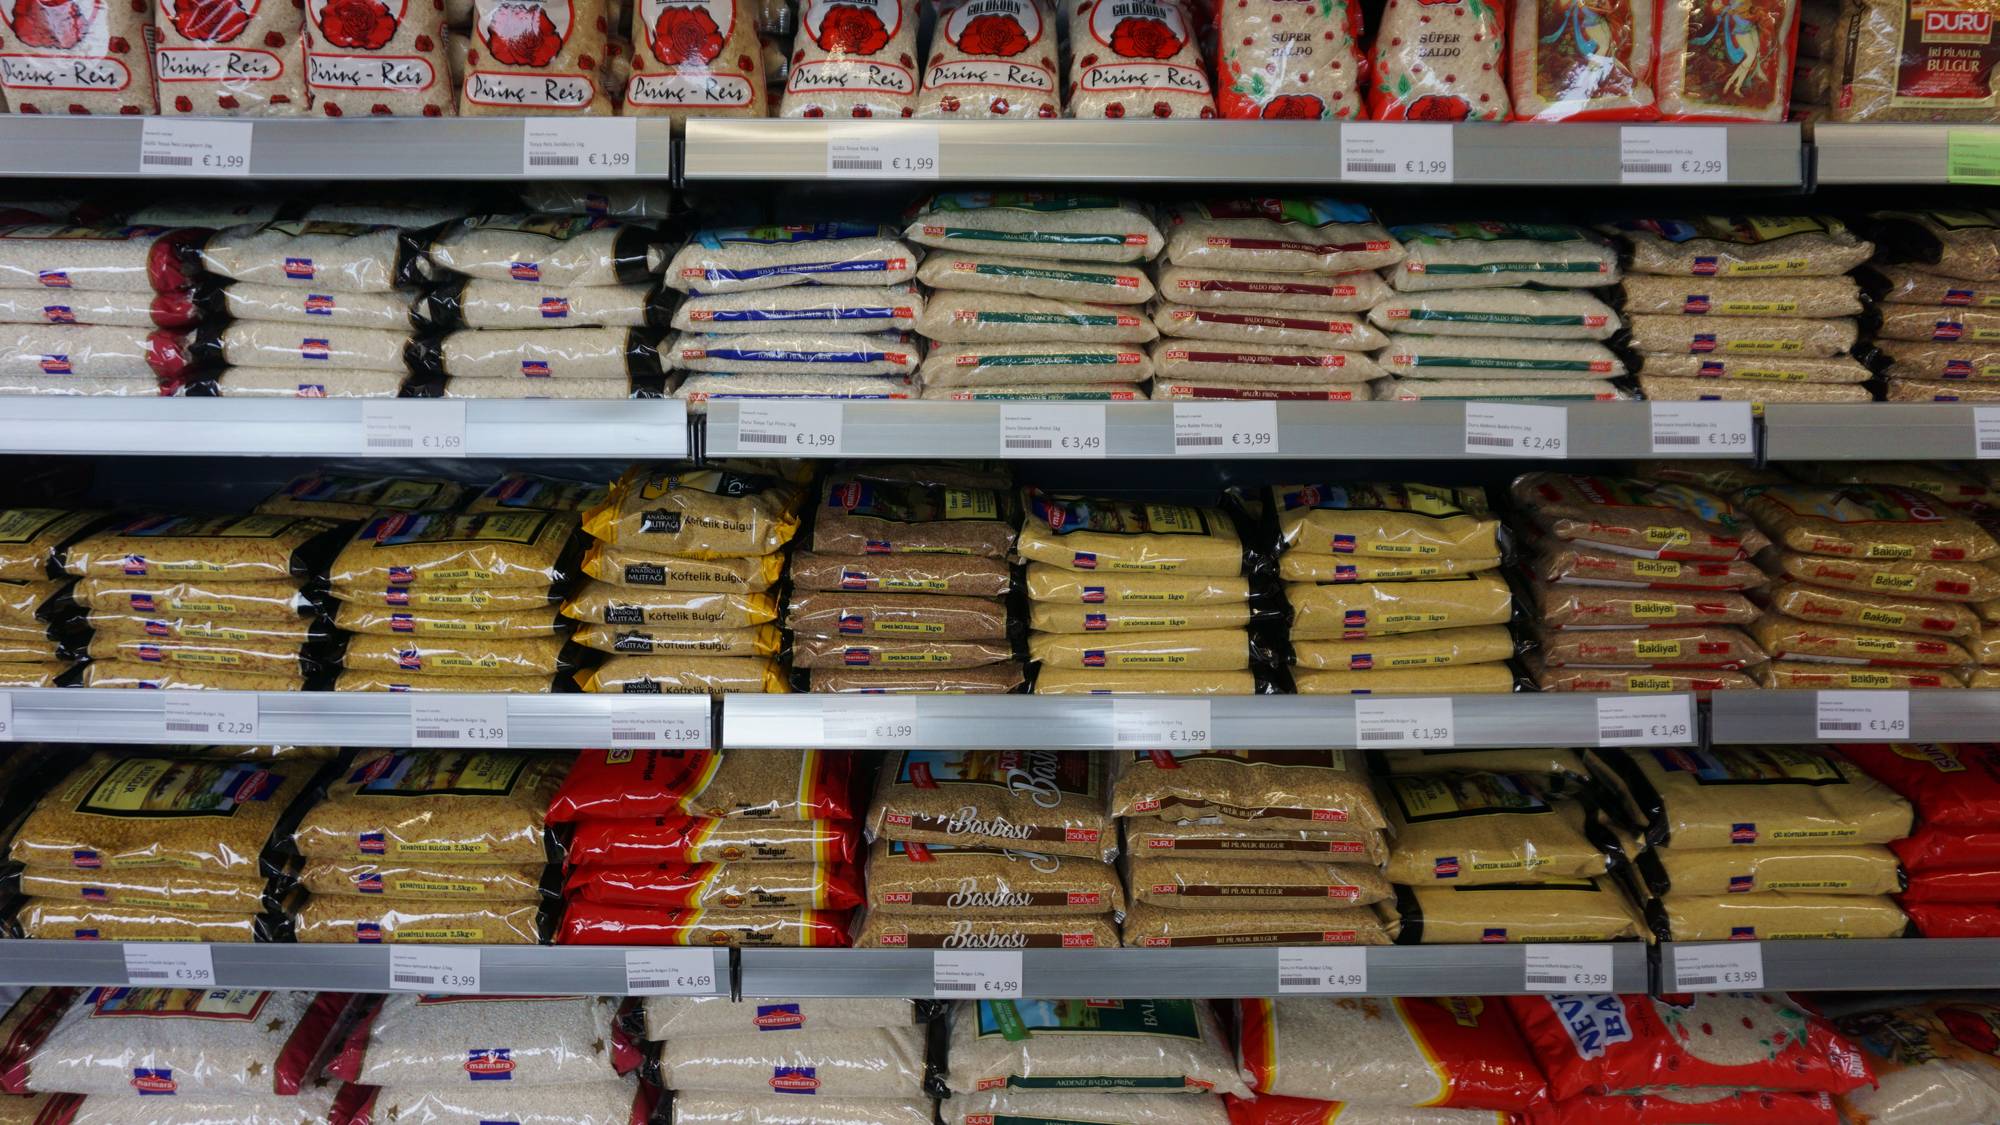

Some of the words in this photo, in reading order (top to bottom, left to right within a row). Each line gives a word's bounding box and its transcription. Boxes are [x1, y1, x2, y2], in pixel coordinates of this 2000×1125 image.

[1927, 12, 1989, 31] DURU
[1271, 32, 1311, 44] SÜPER
[1419, 32, 1460, 44] SÜPER
[228, 53, 269, 74] Reis
[1927, 60, 1980, 72] BULGUR
[74, 61, 117, 85] Reis
[382, 62, 422, 84] Reis
[1008, 65, 1043, 86] Reis
[1167, 68, 1201, 88] Reis
[474, 74, 525, 102] Pirinç
[545, 78, 584, 101] Reis
[706, 78, 743, 101] Reis
[202, 154, 211, 166] €
[216, 155, 244, 168] 1,99
[589, 153, 596, 164] €
[602, 153, 629, 166] 1,99
[892, 158, 900, 169] €
[905, 158, 933, 171] 1,99
[1406, 161, 1414, 172] €
[1419, 161, 1446, 174] 1,99
[1681, 160, 1690, 172] €
[1693, 160, 1721, 174] 2,99
[1180, 280, 1199, 288] DURU
[1168, 349, 1187, 358] DURU
[1172, 386, 1191, 395] DURU
[422, 436, 430, 447] €
[434, 436, 460, 449] 1,69
[796, 433, 804, 444] €
[808, 433, 835, 447] 1,99
[1061, 437, 1069, 448] €
[1072, 437, 1099, 450] 3,49
[1232, 433, 1240, 444] €
[1244, 433, 1270, 446] 3,99
[1522, 436, 1531, 447] €
[1534, 437, 1560, 450] 2,49
[1708, 433, 1716, 444] €
[1720, 433, 1746, 446] 1,99
[631, 568, 662, 576] ANADOLU
[1637, 562, 1677, 574] Bakliyat
[671, 571, 711, 583] Köftelik
[1875, 575, 1913, 587] Bakliyat
[649, 610, 688, 621] Köftelik
[692, 611, 725, 624] Bulgur
[1863, 611, 1902, 624] Bakliyat
[1638, 644, 1678, 656] Bakliyat
[1631, 680, 1670, 691] Bakliyat
[1851, 674, 1889, 686] Bakliyat
[666, 685, 704, 694] Köftelik
[217, 722, 224, 732] €
[228, 722, 253, 734] 2,29
[875, 727, 882, 736] €
[887, 723, 912, 738] 1,99
[1650, 725, 1658, 736] €
[1662, 724, 1686, 736] 1,49
[1870, 720, 1877, 730] €
[1880, 720, 1904, 732] 1,49
[468, 728, 475, 738] €
[479, 728, 503, 739] 1,99
[664, 729, 672, 740] €
[675, 729, 699, 741] 1,99
[1170, 730, 1177, 741] €
[1182, 730, 1206, 742] 1,99
[1412, 729, 1420, 739] €
[1424, 728, 1448, 740] 1,99
[1136, 801, 1159, 810] DURU
[888, 815, 910, 824] DURU
[947, 806, 1032, 839] Basbası
[1150, 839, 1172, 848] DURU
[758, 847, 787, 857] Bulgur
[887, 892, 910, 903] DURU
[947, 878, 1034, 909] Basbası
[1153, 885, 1175, 894] DURU
[759, 893, 787, 904] Bulgur
[746, 932, 774, 942] Bulgur
[883, 935, 905, 945] DURU
[944, 920, 1029, 947] Basbası
[1147, 937, 1169, 946] DURU
[176, 969, 183, 978] €
[186, 970, 209, 981] 3,99
[441, 975, 448, 984] €
[452, 976, 475, 986] 3,99
[1328, 975, 1335, 984] €
[1337, 975, 1361, 986] 4,99
[1574, 974, 1581, 984] €
[1584, 974, 1607, 986] 3,99
[1725, 973, 1732, 982] €
[1734, 971, 1757, 983] 3,99
[677, 977, 684, 986] €
[687, 976, 710, 987] 4,69
[984, 981, 991, 990] €
[994, 980, 1017, 992] 4,99
[759, 1015, 801, 1024] marmara
[469, 1062, 511, 1070] marmara
[775, 1079, 816, 1087] marmara
[980, 1079, 1004, 1089] DURU
